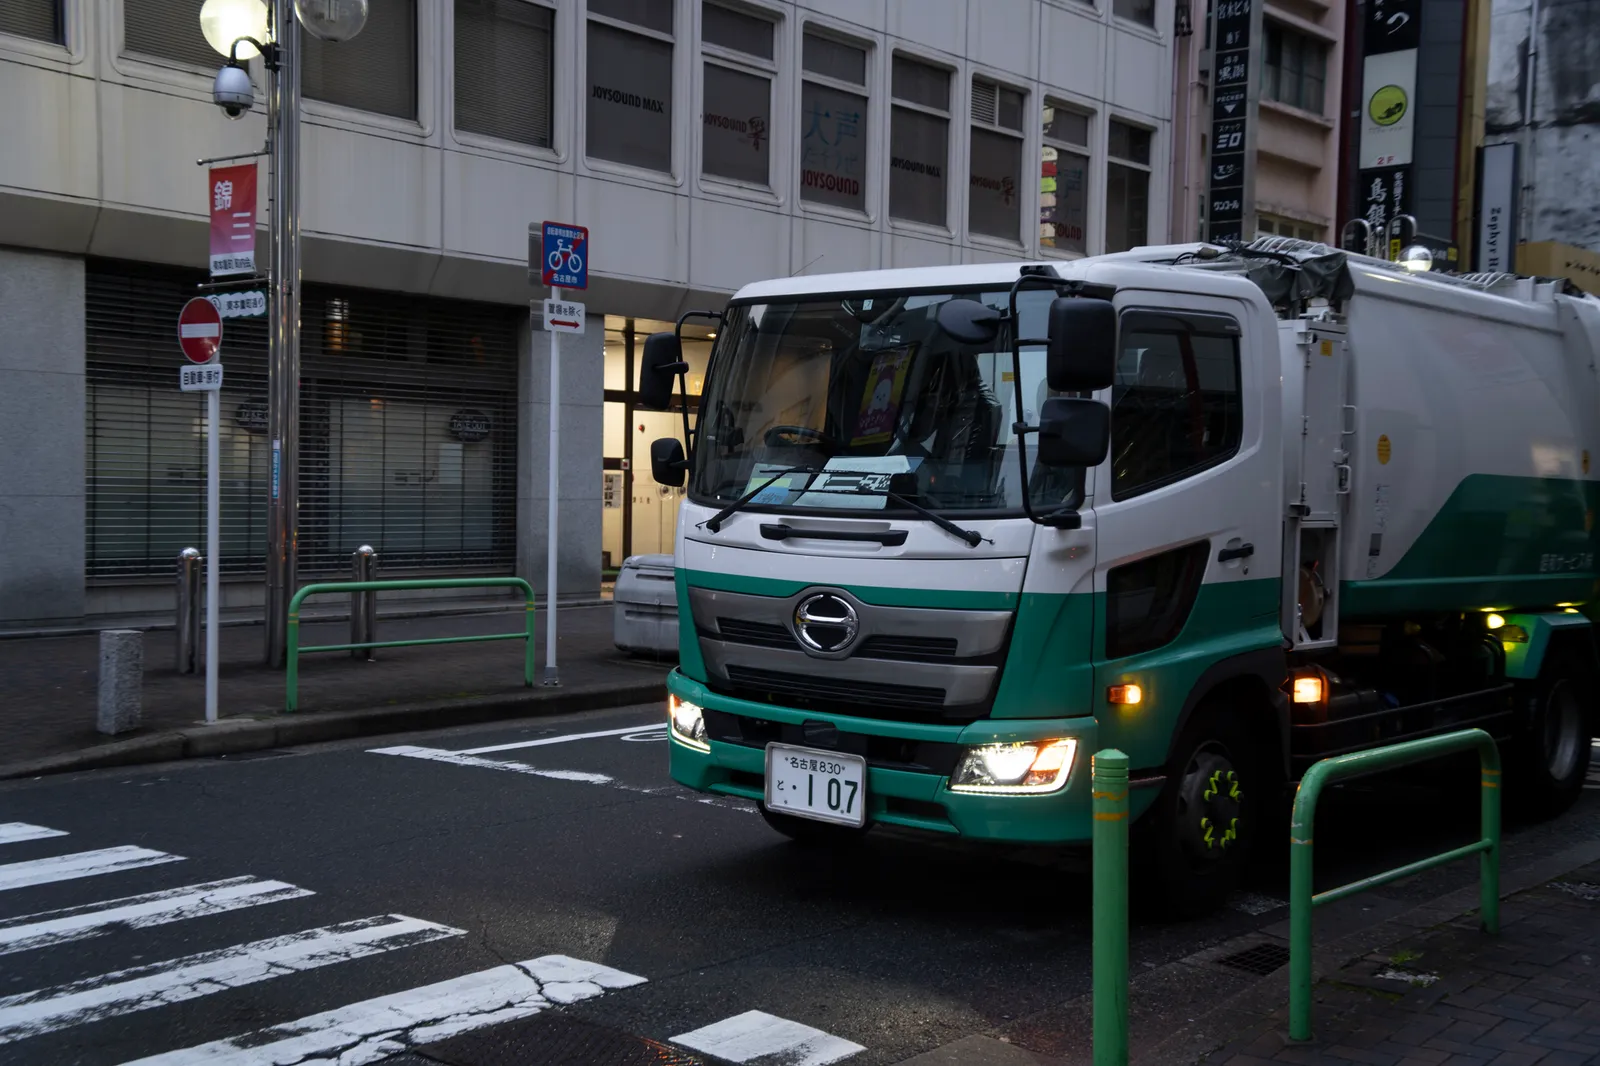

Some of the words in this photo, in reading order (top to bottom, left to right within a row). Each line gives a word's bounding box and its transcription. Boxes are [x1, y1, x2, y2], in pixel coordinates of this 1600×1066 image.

[592, 85, 641, 108] JOYSOUND
[642, 98, 664, 114] MAX
[704, 112, 747, 133] JOYSOUND
[890, 157, 925, 174] JOYSOUND
[926, 165, 941, 178] MAX
[801, 169, 859, 196] JOYSOUND
[1486, 207, 1502, 253] Zephyr
[552, 273, 578, 284] 名古屋市
[548, 303, 581, 317] 置場を除く
[777, 780, 784, 791] と
